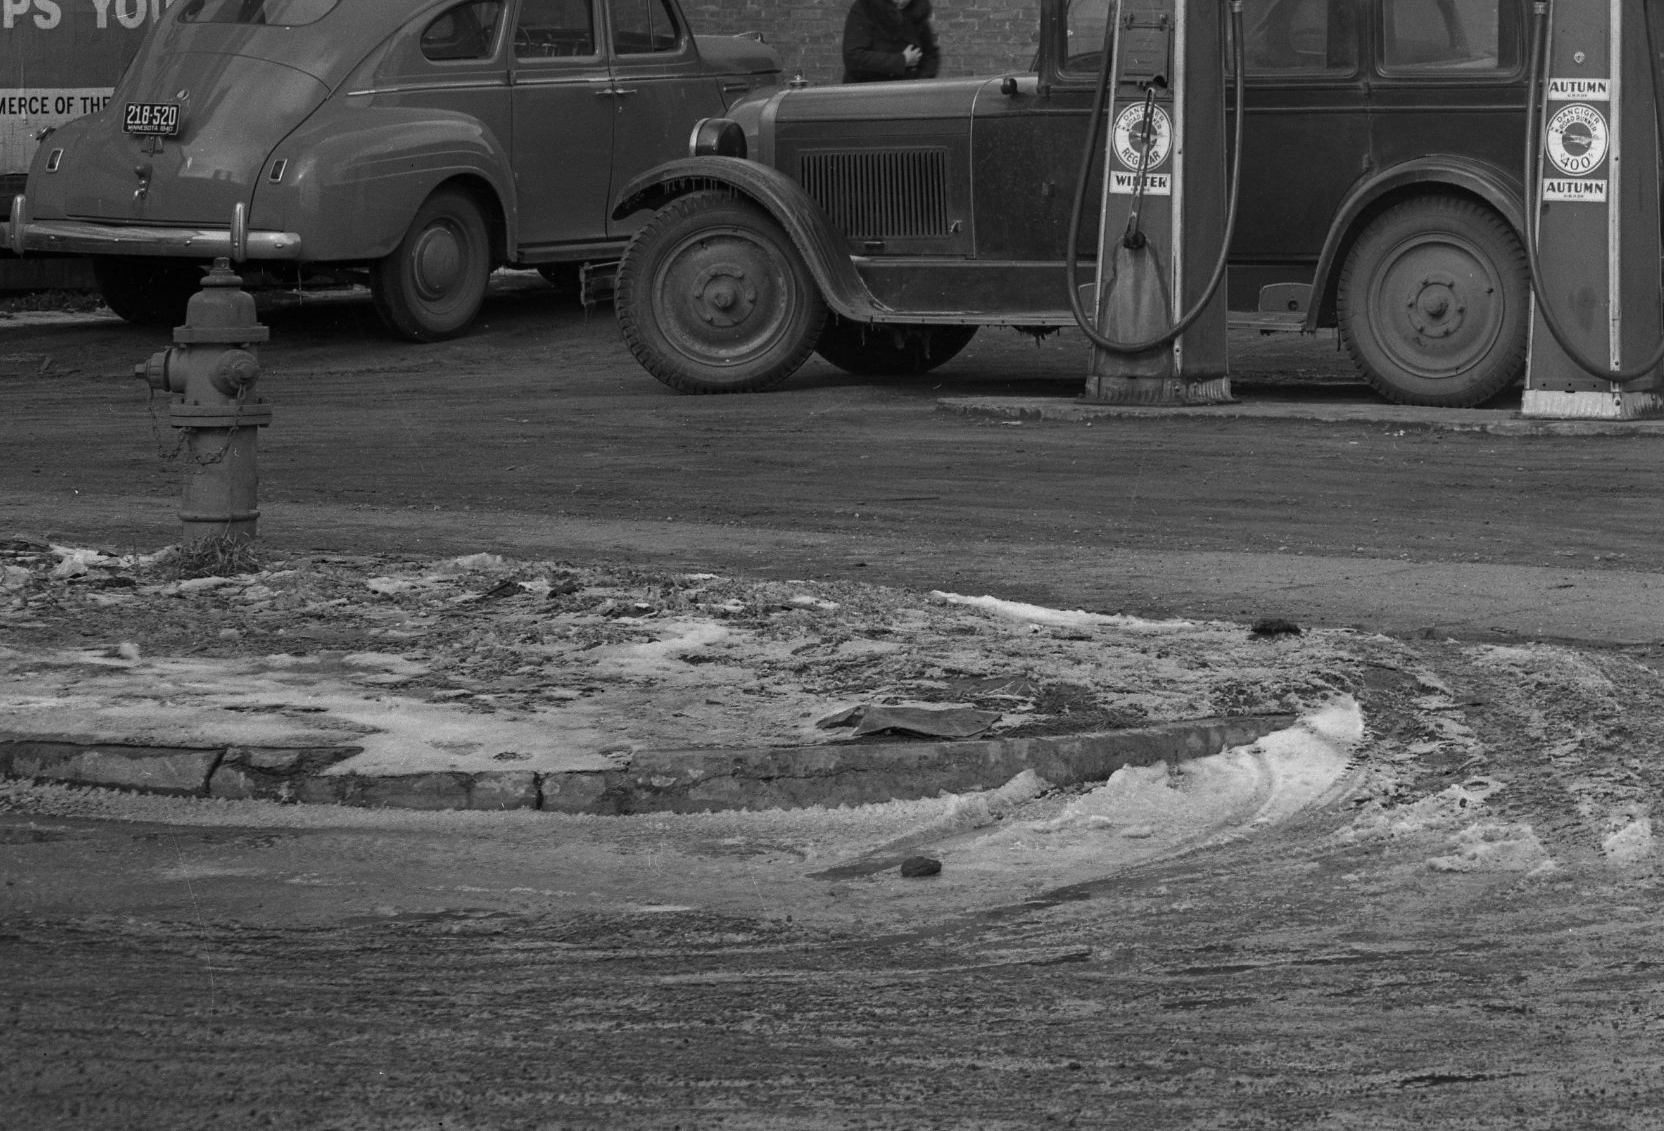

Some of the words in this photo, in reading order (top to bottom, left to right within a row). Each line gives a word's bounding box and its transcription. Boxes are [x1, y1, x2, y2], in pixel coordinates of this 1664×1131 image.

[1549, 81, 1606, 93] AUTUMN
[55, 96, 74, 114] OF
[1557, 107, 1600, 125] DANCIGER
[1575, 114, 1597, 132] RUNNER
[1121, 147, 1161, 166] REGAR
[1546, 182, 1604, 194] AUTUMN
